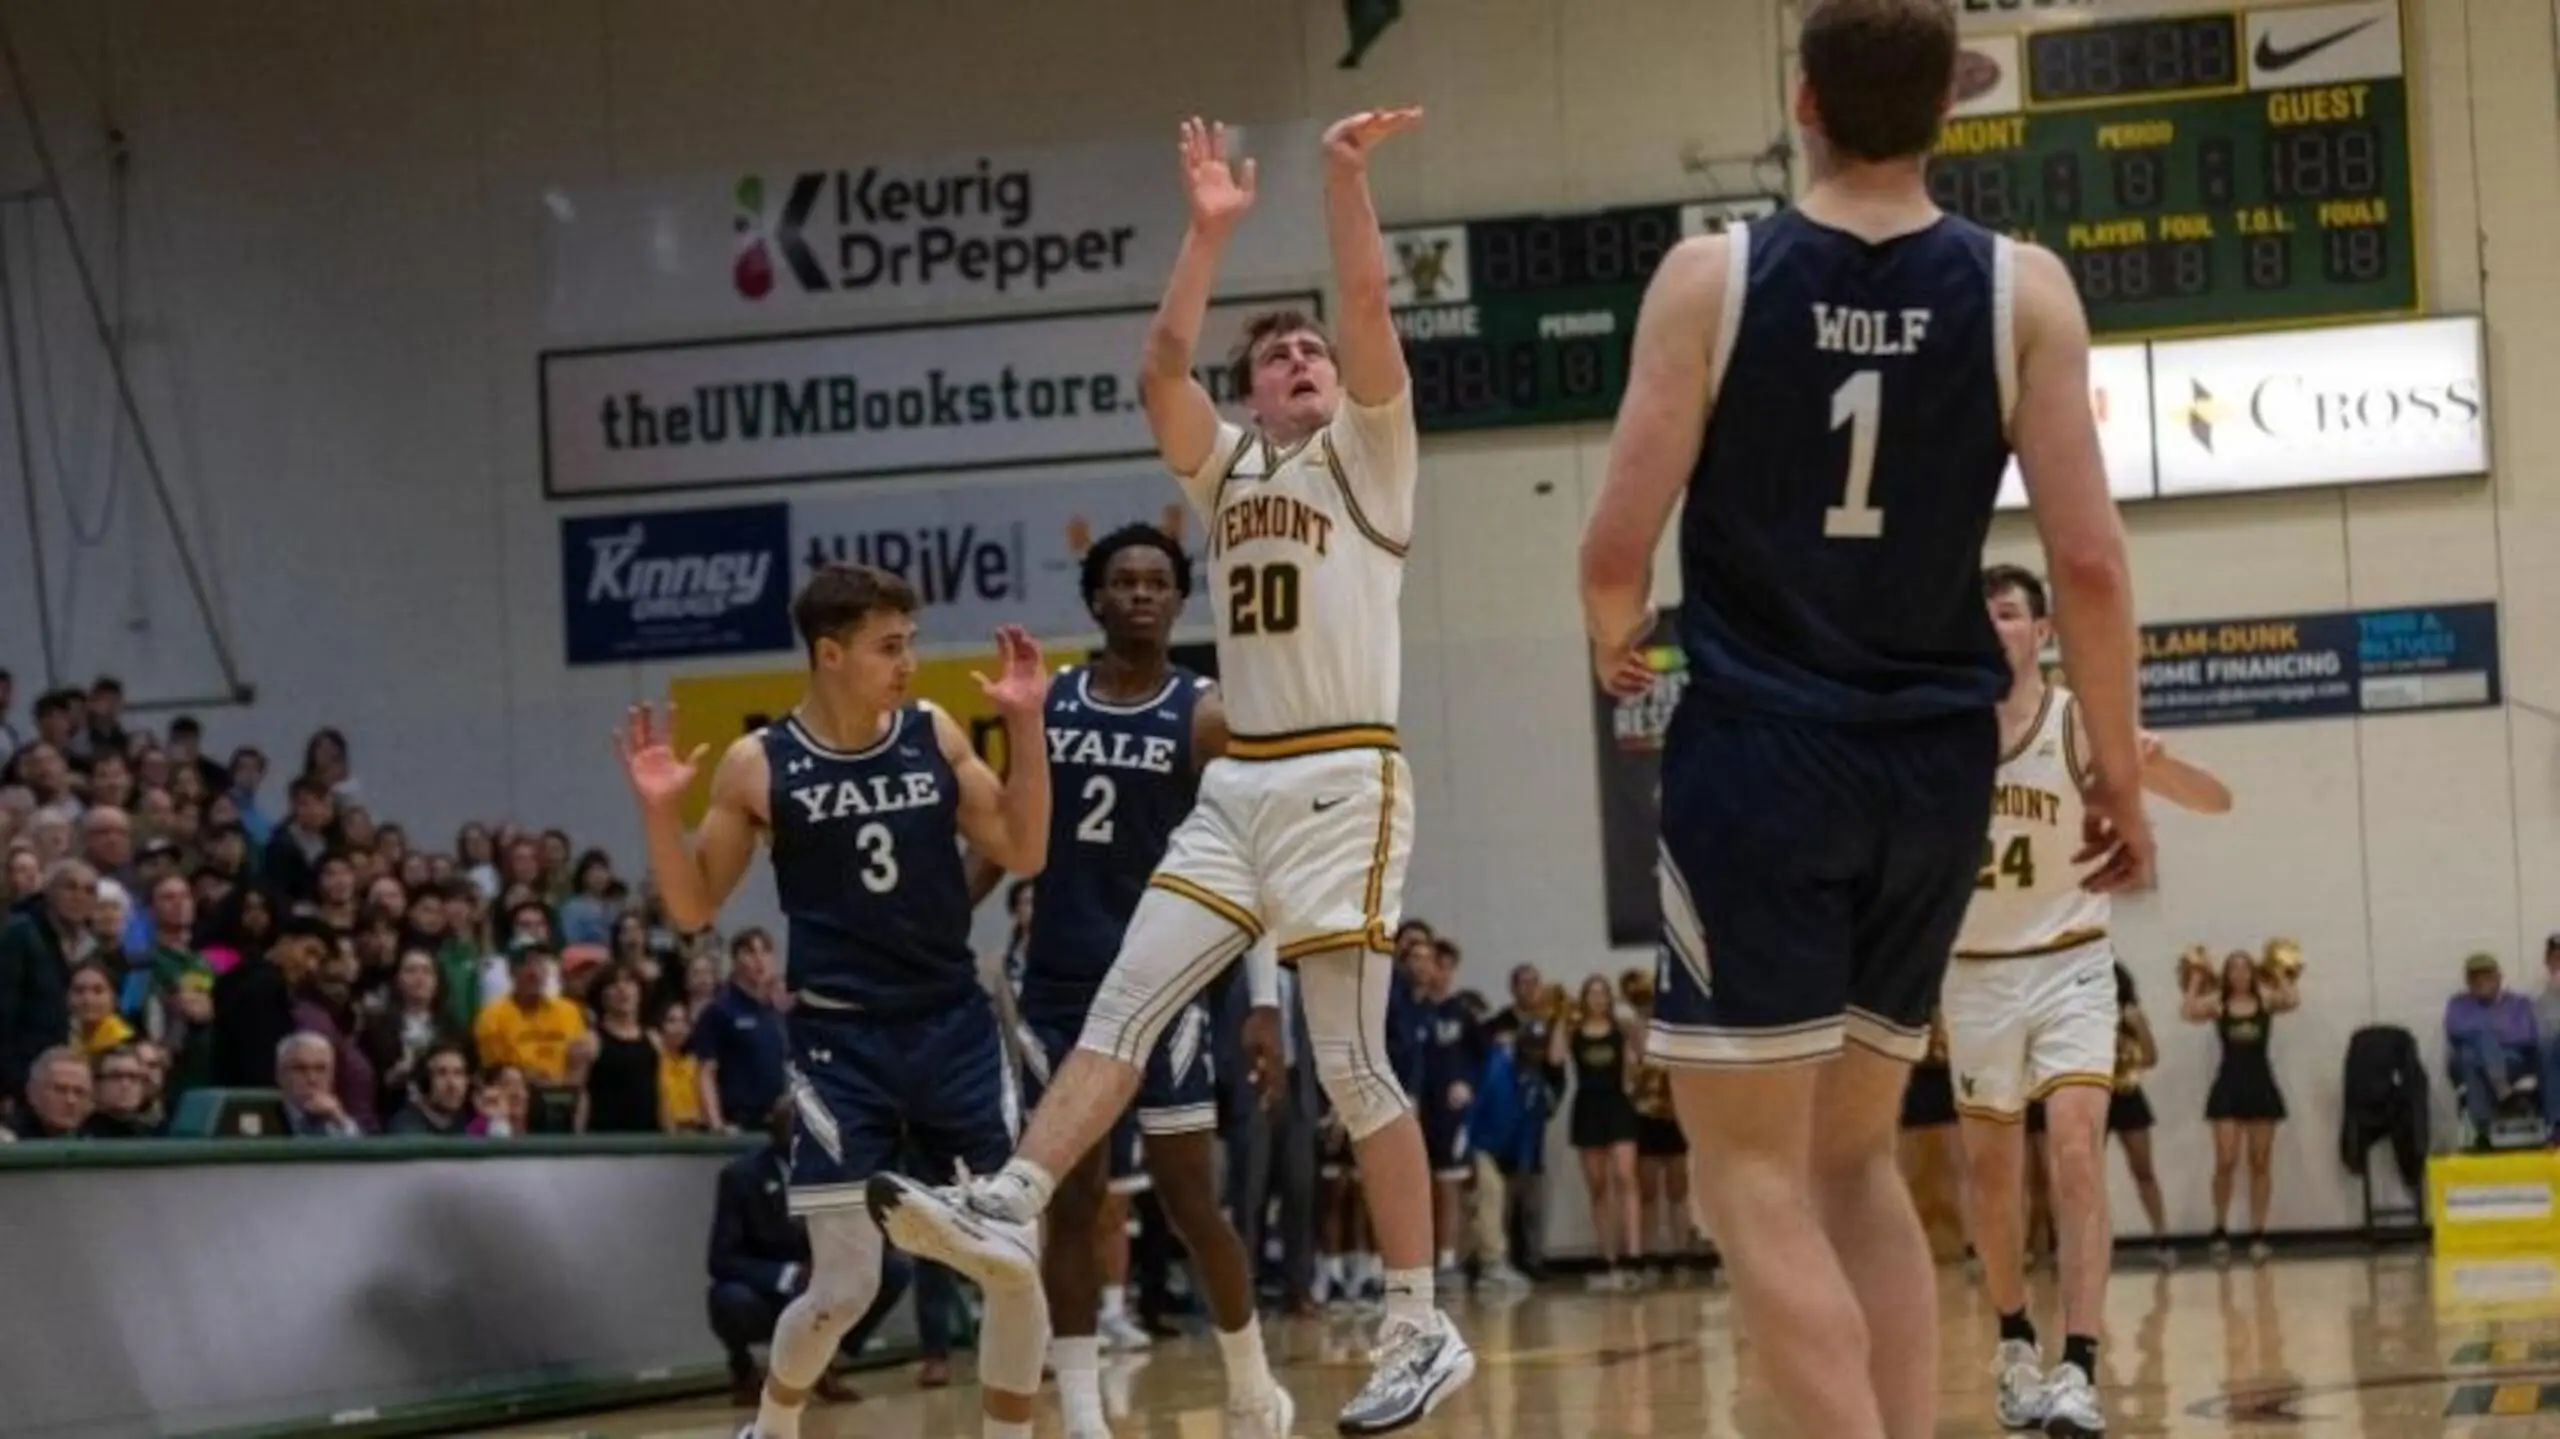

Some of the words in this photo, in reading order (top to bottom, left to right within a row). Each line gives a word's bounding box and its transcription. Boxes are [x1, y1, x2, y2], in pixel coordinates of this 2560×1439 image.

[2267, 86, 2369, 126] GUEST
[1932, 117, 2027, 155] MONT
[2097, 120, 2175, 150] PERIOD
[835, 156, 1032, 229] Keurig
[2068, 219, 2147, 248] PLAYER
[2158, 212, 2215, 241] FOUL
[1811, 302, 1932, 355] WOLF
[1823, 369, 1884, 538] 1
[586, 522, 772, 606] Kinney
[1229, 562, 1299, 635] 20
[2207, 650, 2341, 683] FINANCING
[1046, 728, 1176, 773] YALE
[791, 771, 940, 824] YALE
[1076, 775, 1119, 844] 2
[855, 822, 899, 893] 3
